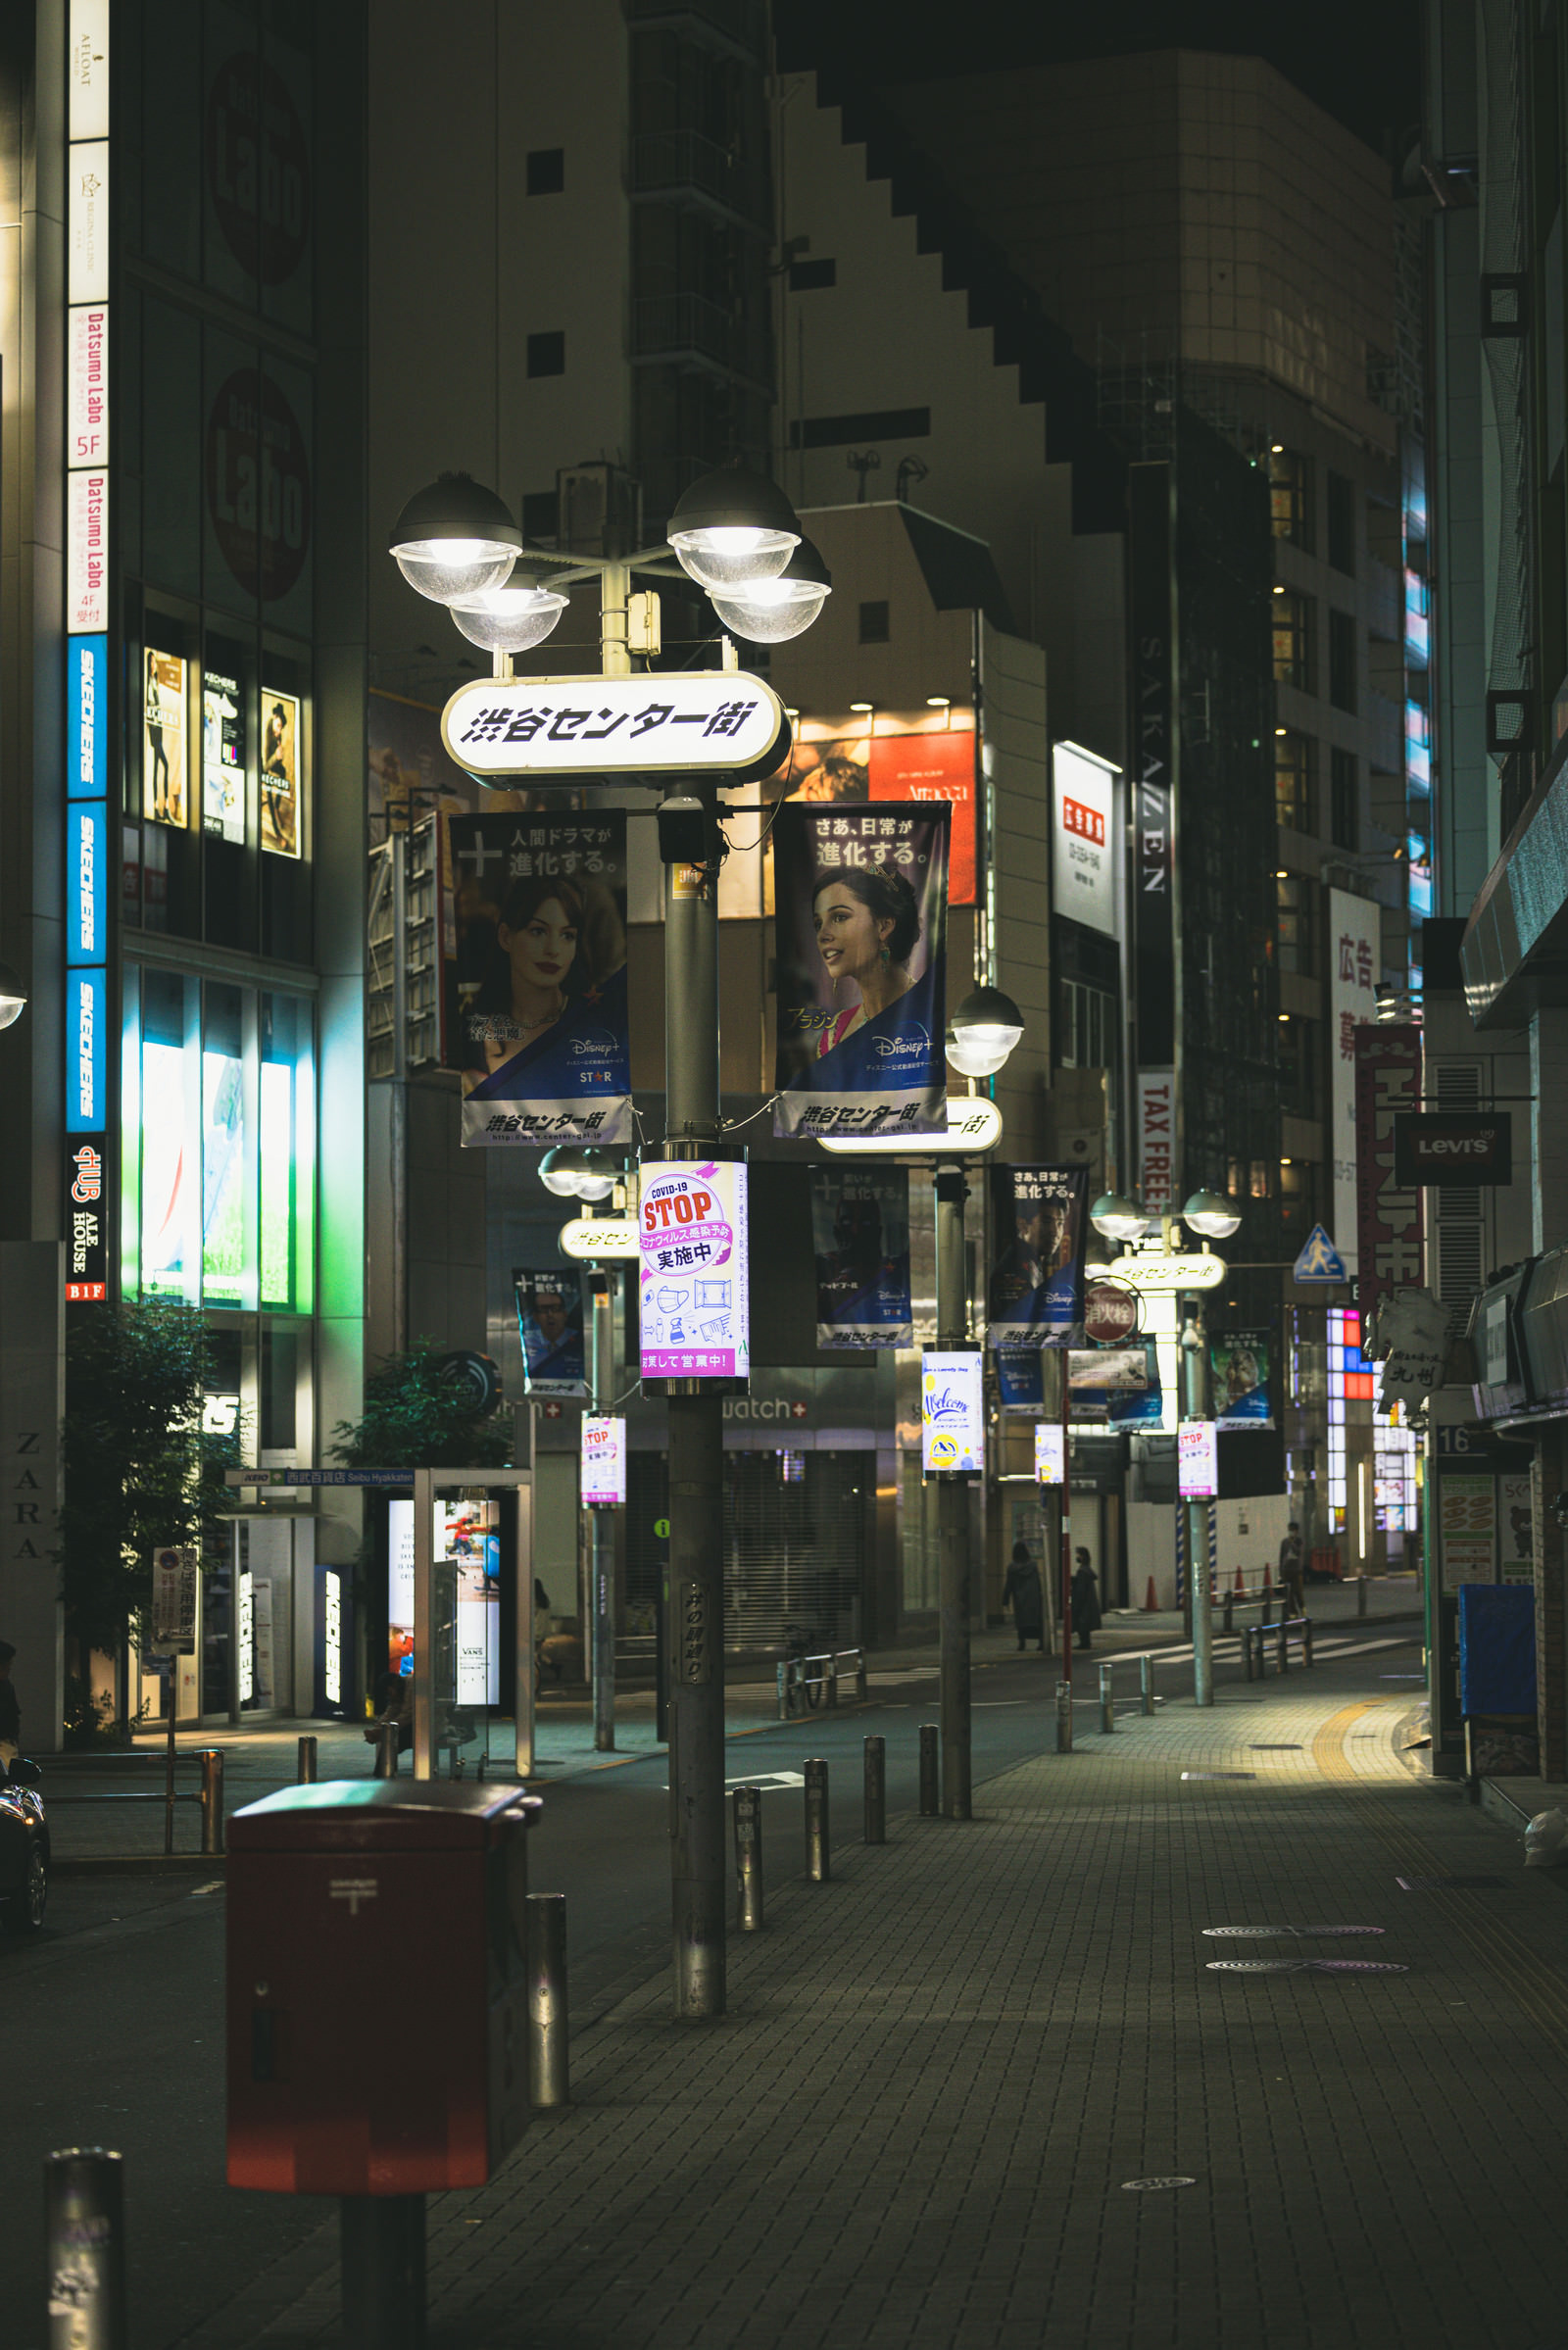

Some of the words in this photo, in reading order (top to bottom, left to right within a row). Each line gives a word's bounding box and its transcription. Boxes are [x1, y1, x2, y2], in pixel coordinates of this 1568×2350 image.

[80, 33, 91, 86] AFLOAT
[88, 313, 105, 382] Datsumo
[88, 388, 105, 425] Labo
[77, 435, 101, 457] 5F
[217, 427, 303, 550] Labo
[88, 477, 105, 547] Datsumo
[88, 553, 105, 590] Labo
[76, 610, 101, 623] 受付
[81, 595, 95, 607] 4F
[204, 671, 237, 691] KECHERS
[79, 648, 96, 784] SKECHERS
[461, 701, 759, 743] 渋谷センター街
[262, 772, 291, 791] KECHERS
[1141, 637, 1165, 894] SAKAZEN
[510, 827, 612, 847] 人間ドラマが
[815, 817, 914, 837] さあ、日常が
[509, 850, 617, 877] 進化する。
[816, 841, 927, 867] 進化する。
[79, 814, 96, 952] SKECHERS
[1339, 930, 1373, 993] 広告
[79, 981, 95, 1119] SKECHERS
[485, 1111, 608, 1132] 渋谷センター街
[801, 1102, 921, 1124] 渋谷センター街
[1144, 1084, 1169, 1135] TAX
[72, 1146, 101, 1203] HUB
[1145, 1141, 1170, 1201] FREE
[652, 1181, 688, 1199] COVID-19
[1013, 1185, 1075, 1199] 進化する。
[644, 1191, 712, 1232] STOP
[74, 1212, 87, 1274] HOUSE
[86, 1211, 99, 1248] ALE
[657, 1243, 711, 1270] 実施中
[70, 1285, 102, 1299] B1F
[1085, 1301, 1130, 1325] 消火栓
[925, 1388, 969, 1417] Welcome
[1441, 1427, 1469, 1452] 16
[287, 1471, 346, 1484] 西武百貨店
[348, 1473, 370, 1483] Seibu
[372, 1473, 414, 1484] Hyakkaten
[13, 1433, 42, 1560] ZARA
